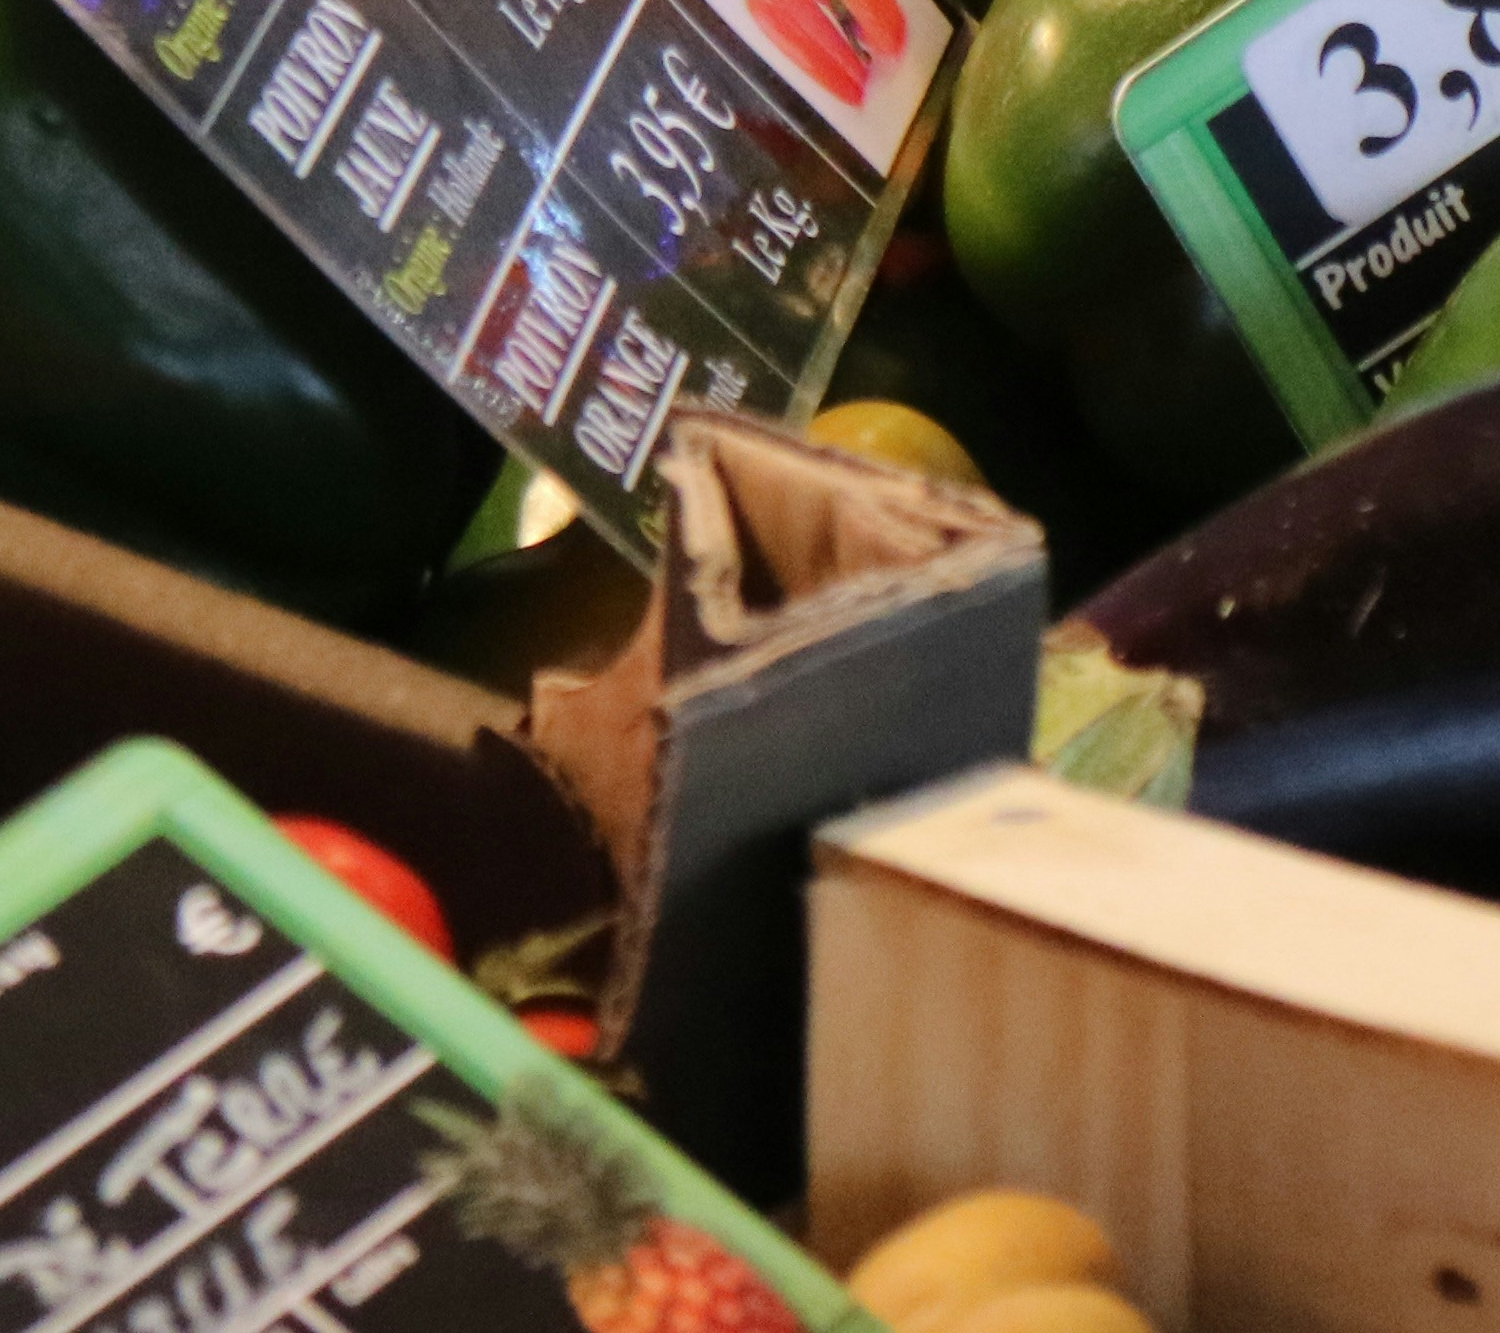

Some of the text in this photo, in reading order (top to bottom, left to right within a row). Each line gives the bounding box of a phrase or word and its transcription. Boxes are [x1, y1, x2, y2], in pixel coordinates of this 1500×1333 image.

[334, 76, 430, 220] JAUNE
[608, 45, 737, 236] 3,95 €
[731, 185, 820, 285] Le Kg.
[1312, 182, 1472, 311] Produit
[494, 242, 604, 413] POIVRON
[573, 306, 678, 475] ORANGE
[176, 882, 265, 956] €
